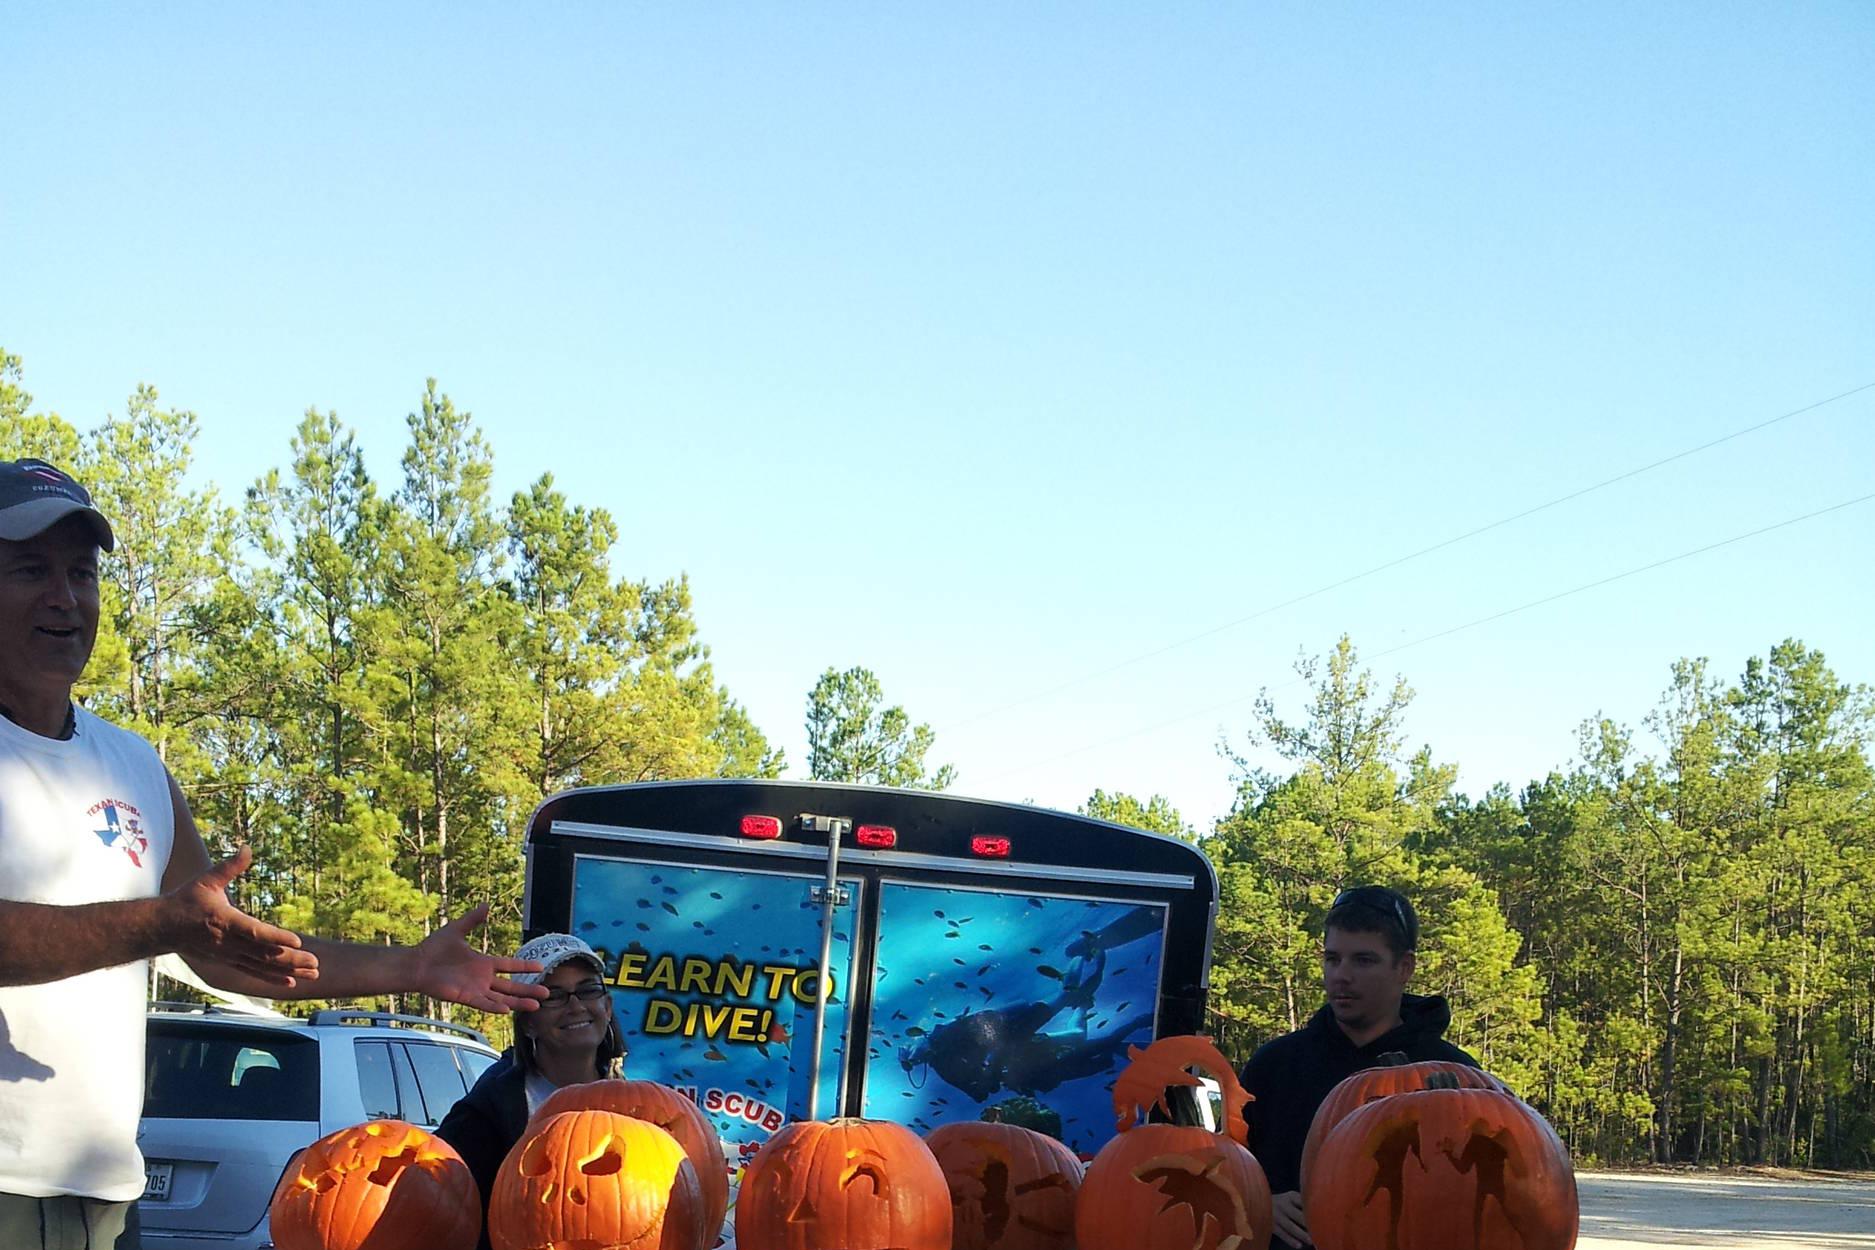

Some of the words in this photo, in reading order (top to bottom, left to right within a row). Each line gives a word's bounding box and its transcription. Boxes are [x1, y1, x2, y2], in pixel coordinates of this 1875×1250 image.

[764, 965, 833, 1004] TO
[645, 999, 772, 1043] DIVE!
[705, 1089, 783, 1132] SCUB
